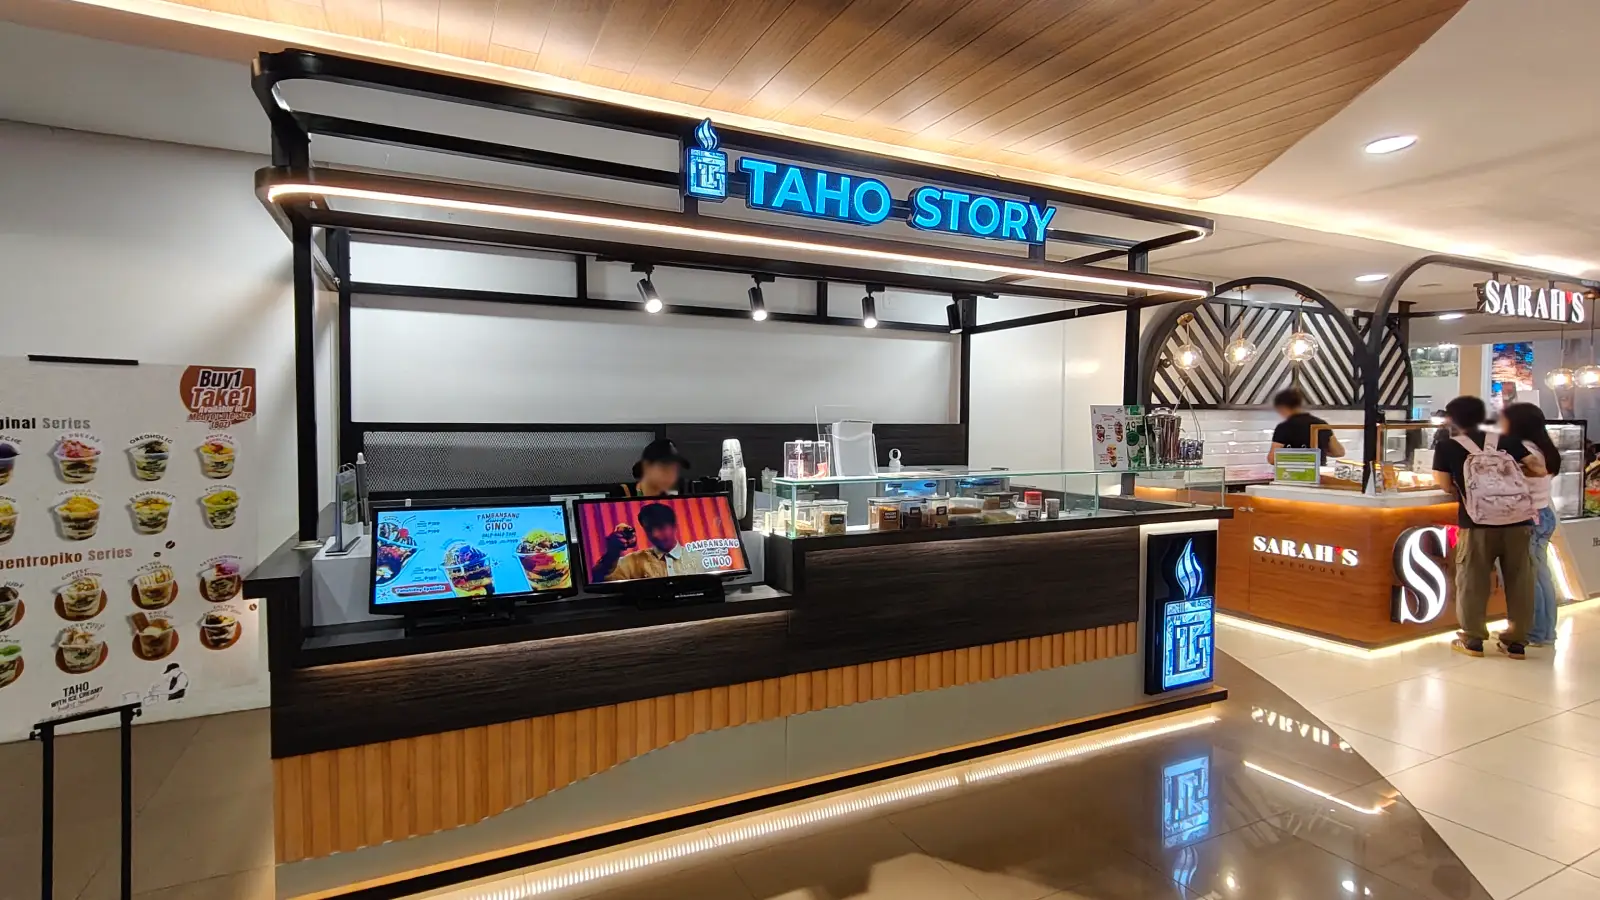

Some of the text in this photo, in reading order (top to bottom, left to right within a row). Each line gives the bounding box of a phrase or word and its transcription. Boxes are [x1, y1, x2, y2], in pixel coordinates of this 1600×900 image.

[740, 157, 1056, 241] TAHO STORY
[1485, 280, 1585, 324] SARAH'S
[42, 417, 91, 429] Series
[485, 522, 514, 532] GINOO
[686, 540, 740, 552] PAMBANSANG
[1253, 535, 1359, 567] SARAH'S
[88, 547, 133, 561] Series
[703, 556, 732, 568] GINOO
[63, 681, 89, 698] TAHO
